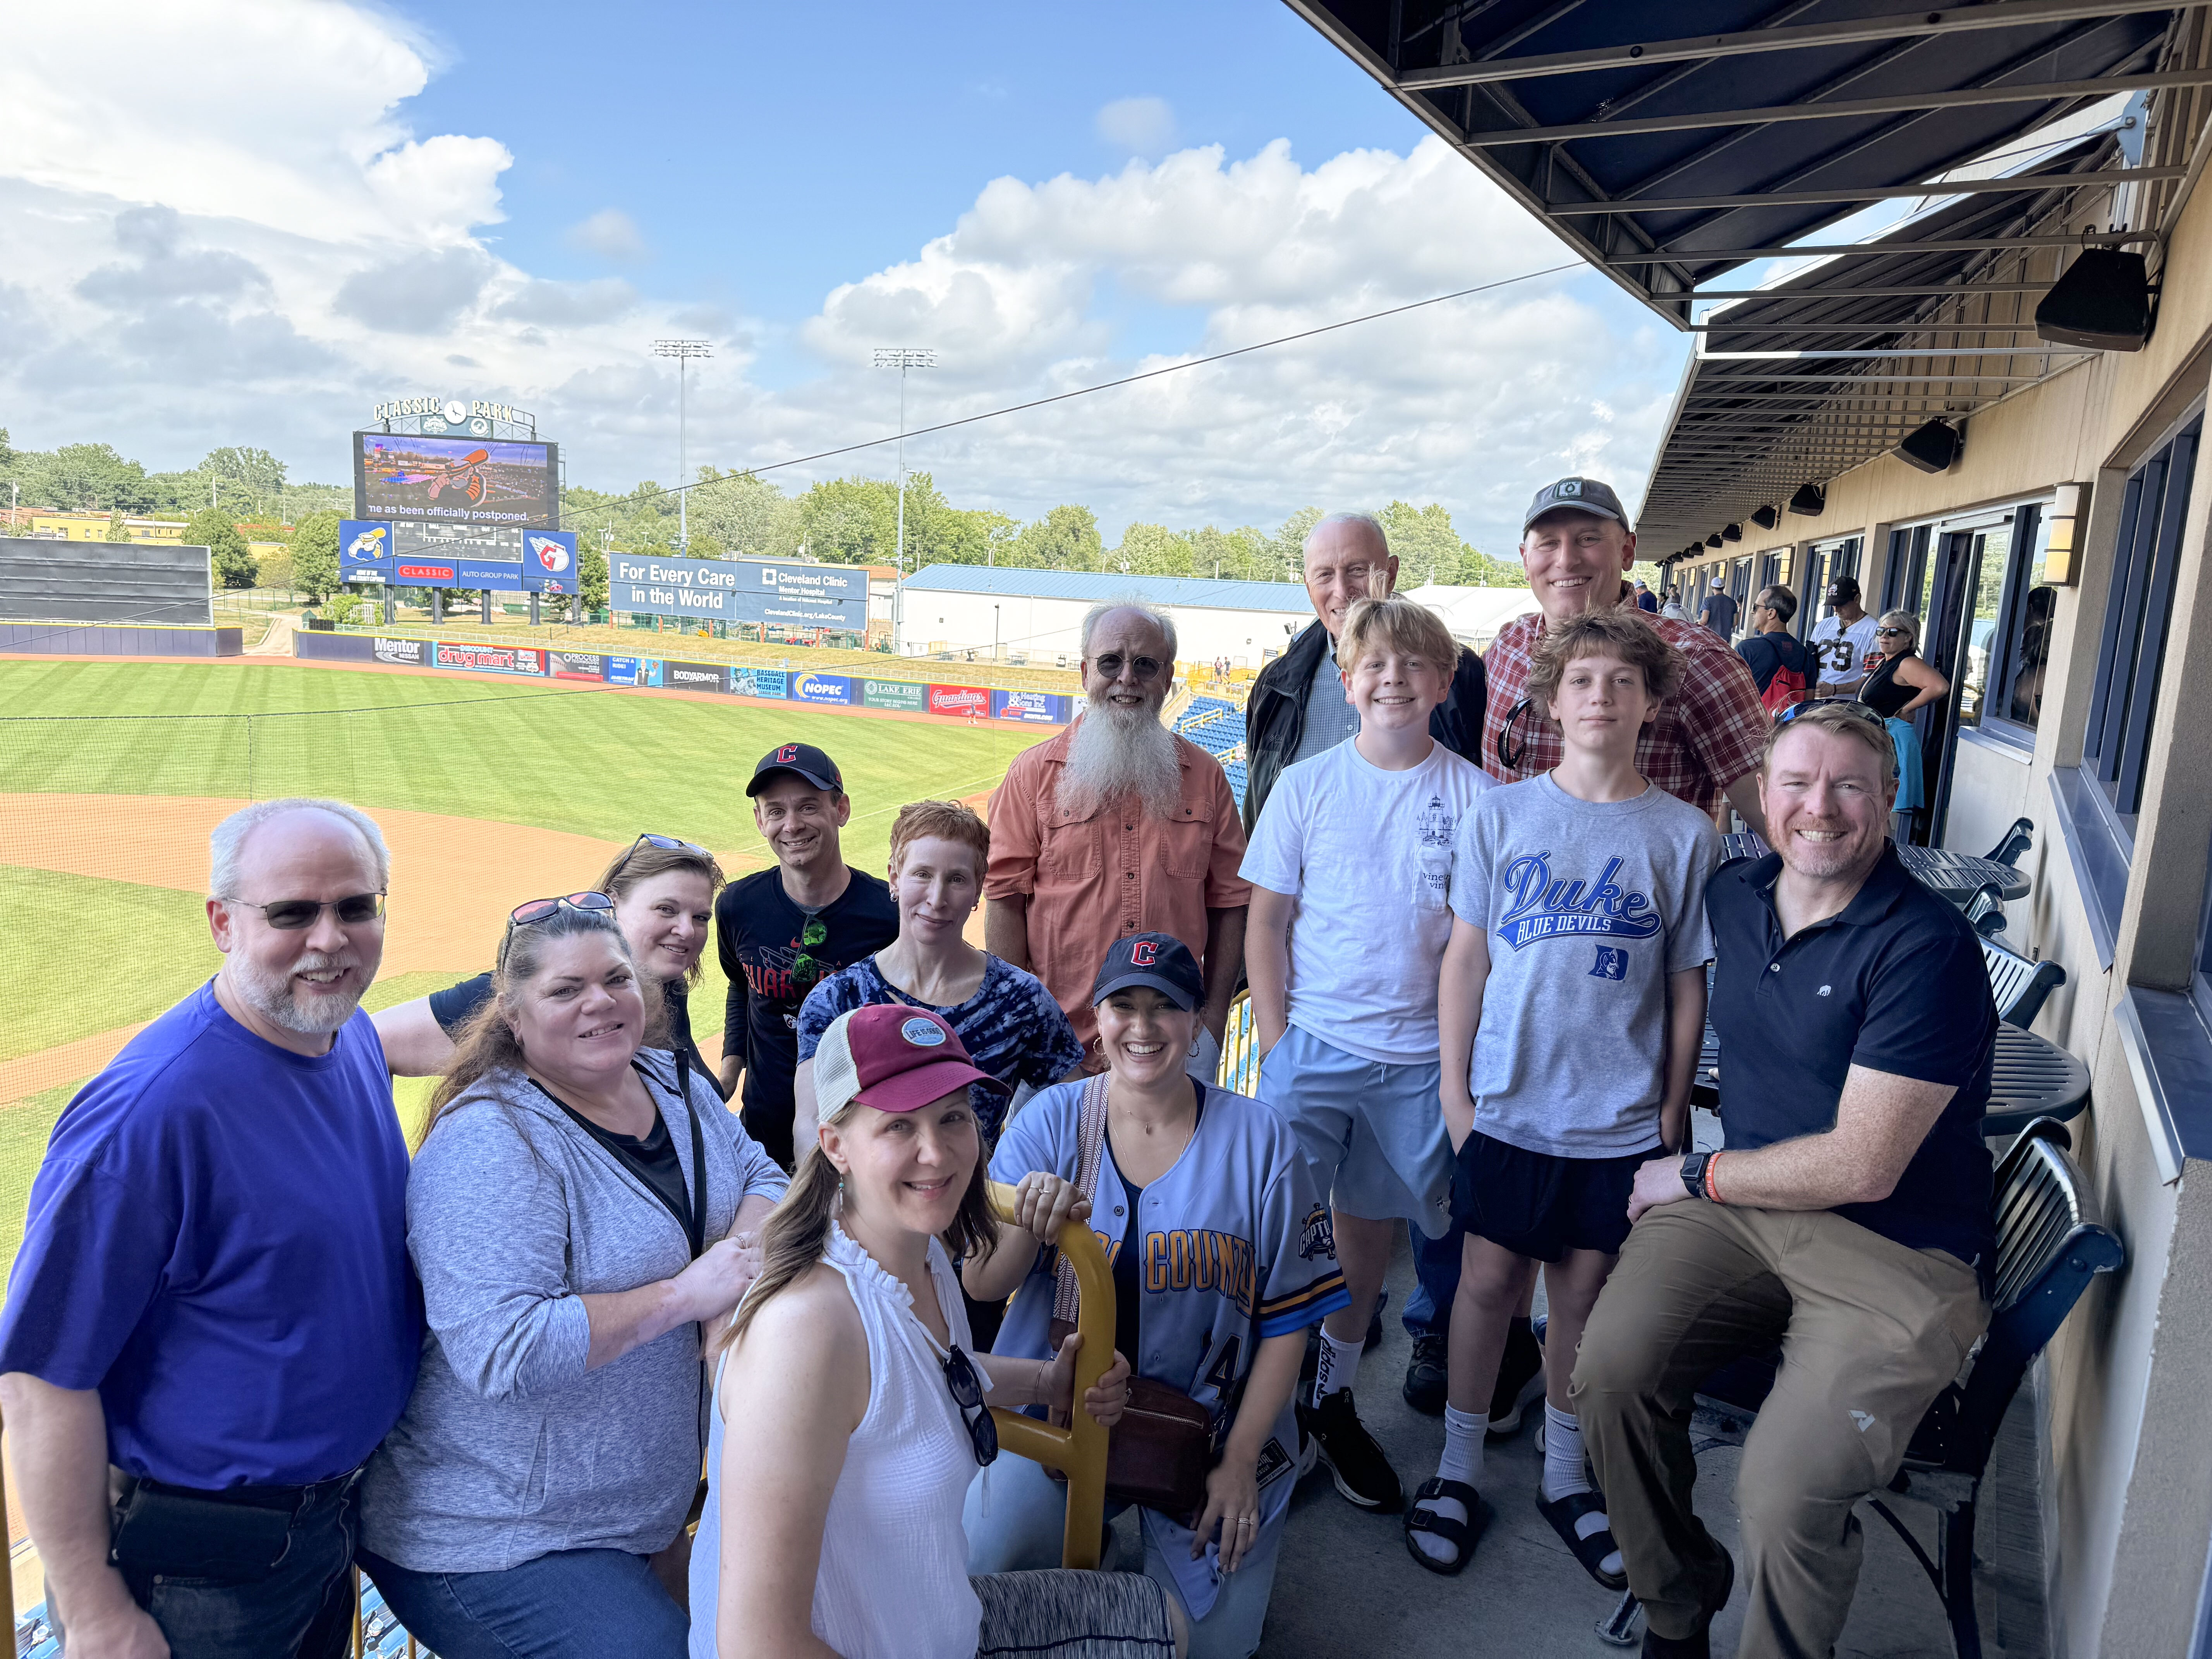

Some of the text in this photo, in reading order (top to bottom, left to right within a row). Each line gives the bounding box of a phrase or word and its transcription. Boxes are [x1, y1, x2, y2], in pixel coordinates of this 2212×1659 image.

[374, 397, 513, 422] CLASSIC PARK
[400, 505, 424, 515] been
[427, 507, 469, 519] officially
[472, 510, 529, 521] postponed.
[403, 568, 450, 577] CLASSIC
[620, 562, 735, 587] For Every Care
[778, 573, 848, 587] Cleveland Clinic
[632, 586, 723, 608] in the World
[779, 586, 825, 596] Mentor Hospital
[374, 637, 420, 653] Mentor
[460, 645, 493, 653] DISCOUNT
[438, 648, 475, 668] drug
[477, 653, 514, 667] mart
[1818, 639, 1854, 672] 29
[674, 670, 719, 683] BODYARMOR
[805, 683, 842, 695] NOPEC
[879, 685, 899, 693] LAKE
[812, 696, 848, 704] www.nopec.org
[933, 690, 984, 708] Guardians
[776, 745, 798, 763] C
[1501, 850, 1659, 925] Duke
[1516, 915, 1611, 945] BLUE DEVILS
[1131, 941, 1159, 966] C
[905, 1029, 922, 1039] LIFE
[1707, 1180, 1715, 1197] HOPE
[1300, 1219, 1331, 1255] CAPTA
[1144, 1229, 1257, 1320] COUNTY
[1256, 1464, 1270, 1477] EAGUE
